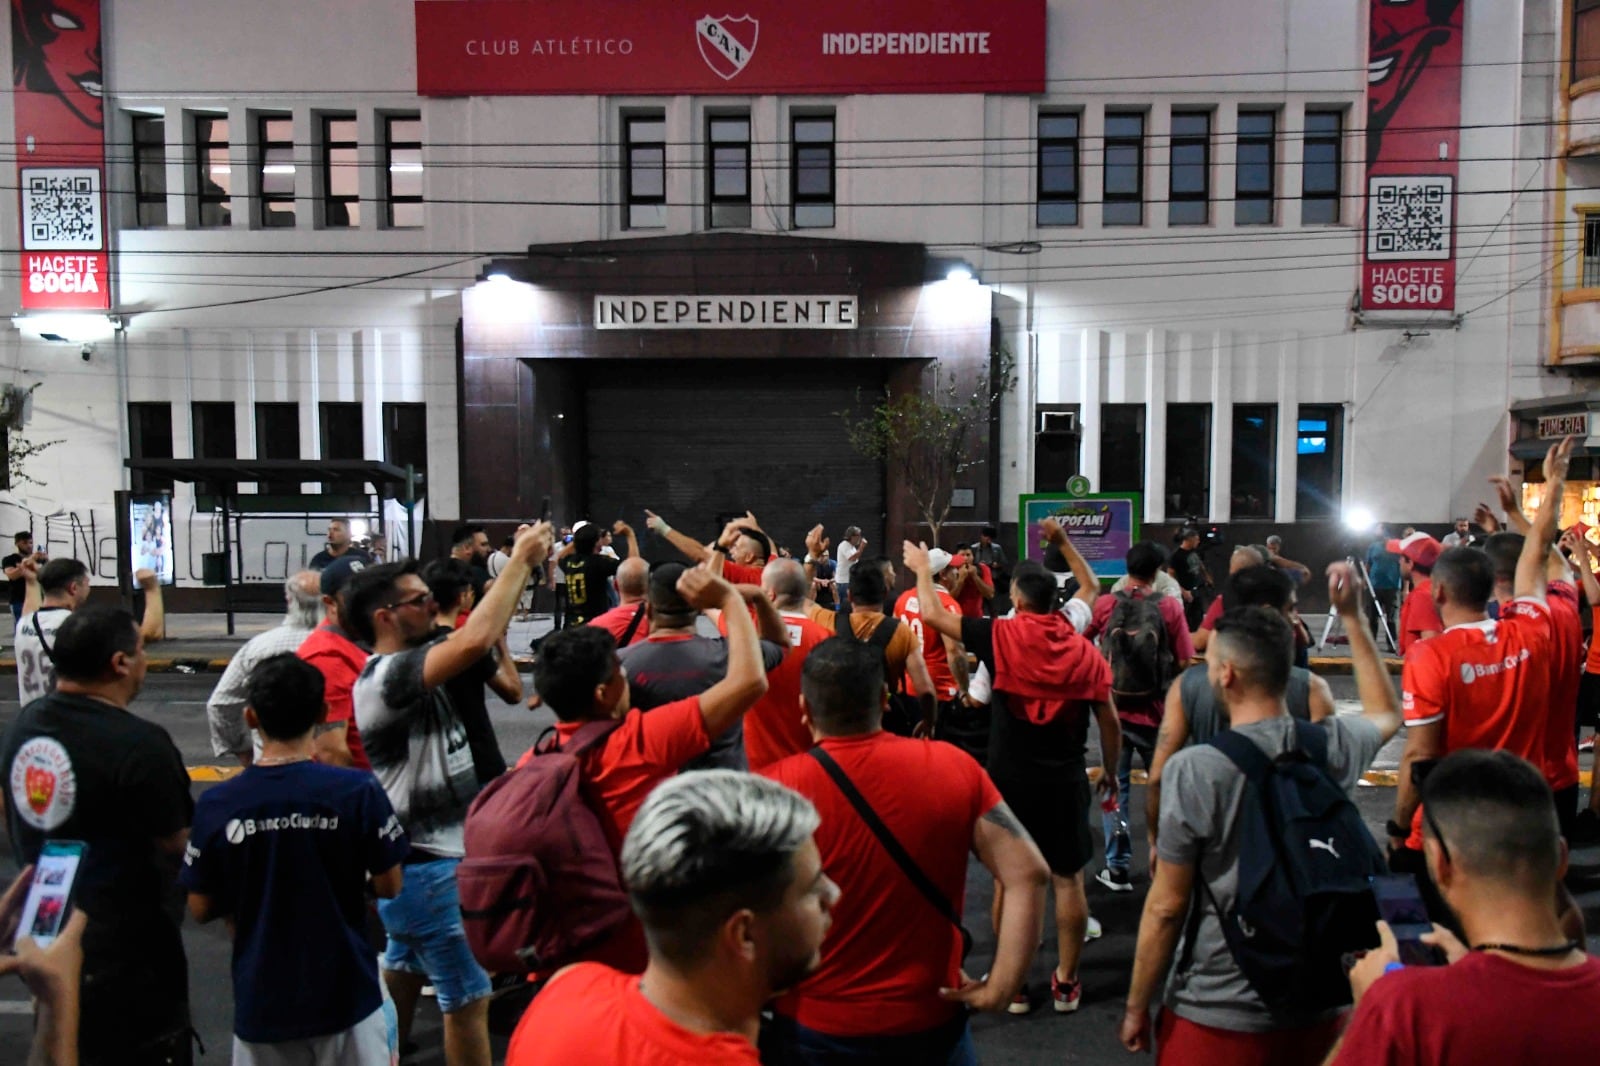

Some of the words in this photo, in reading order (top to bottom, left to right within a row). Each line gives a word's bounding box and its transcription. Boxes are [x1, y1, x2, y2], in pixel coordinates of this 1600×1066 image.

[466, 40, 520, 55] CLUB
[532, 36, 633, 55] ATLÉTICO
[822, 32, 991, 55] INDEPENDIENTE
[29, 255, 98, 273] HACETE
[29, 271, 99, 293] SOCIA
[1372, 267, 1444, 284] HACETE
[1372, 284, 1443, 304] SOCIO
[599, 301, 853, 324] INDEPENDIENTE
[566, 572, 587, 605] 10
[244, 812, 339, 836] BancoCiudad
